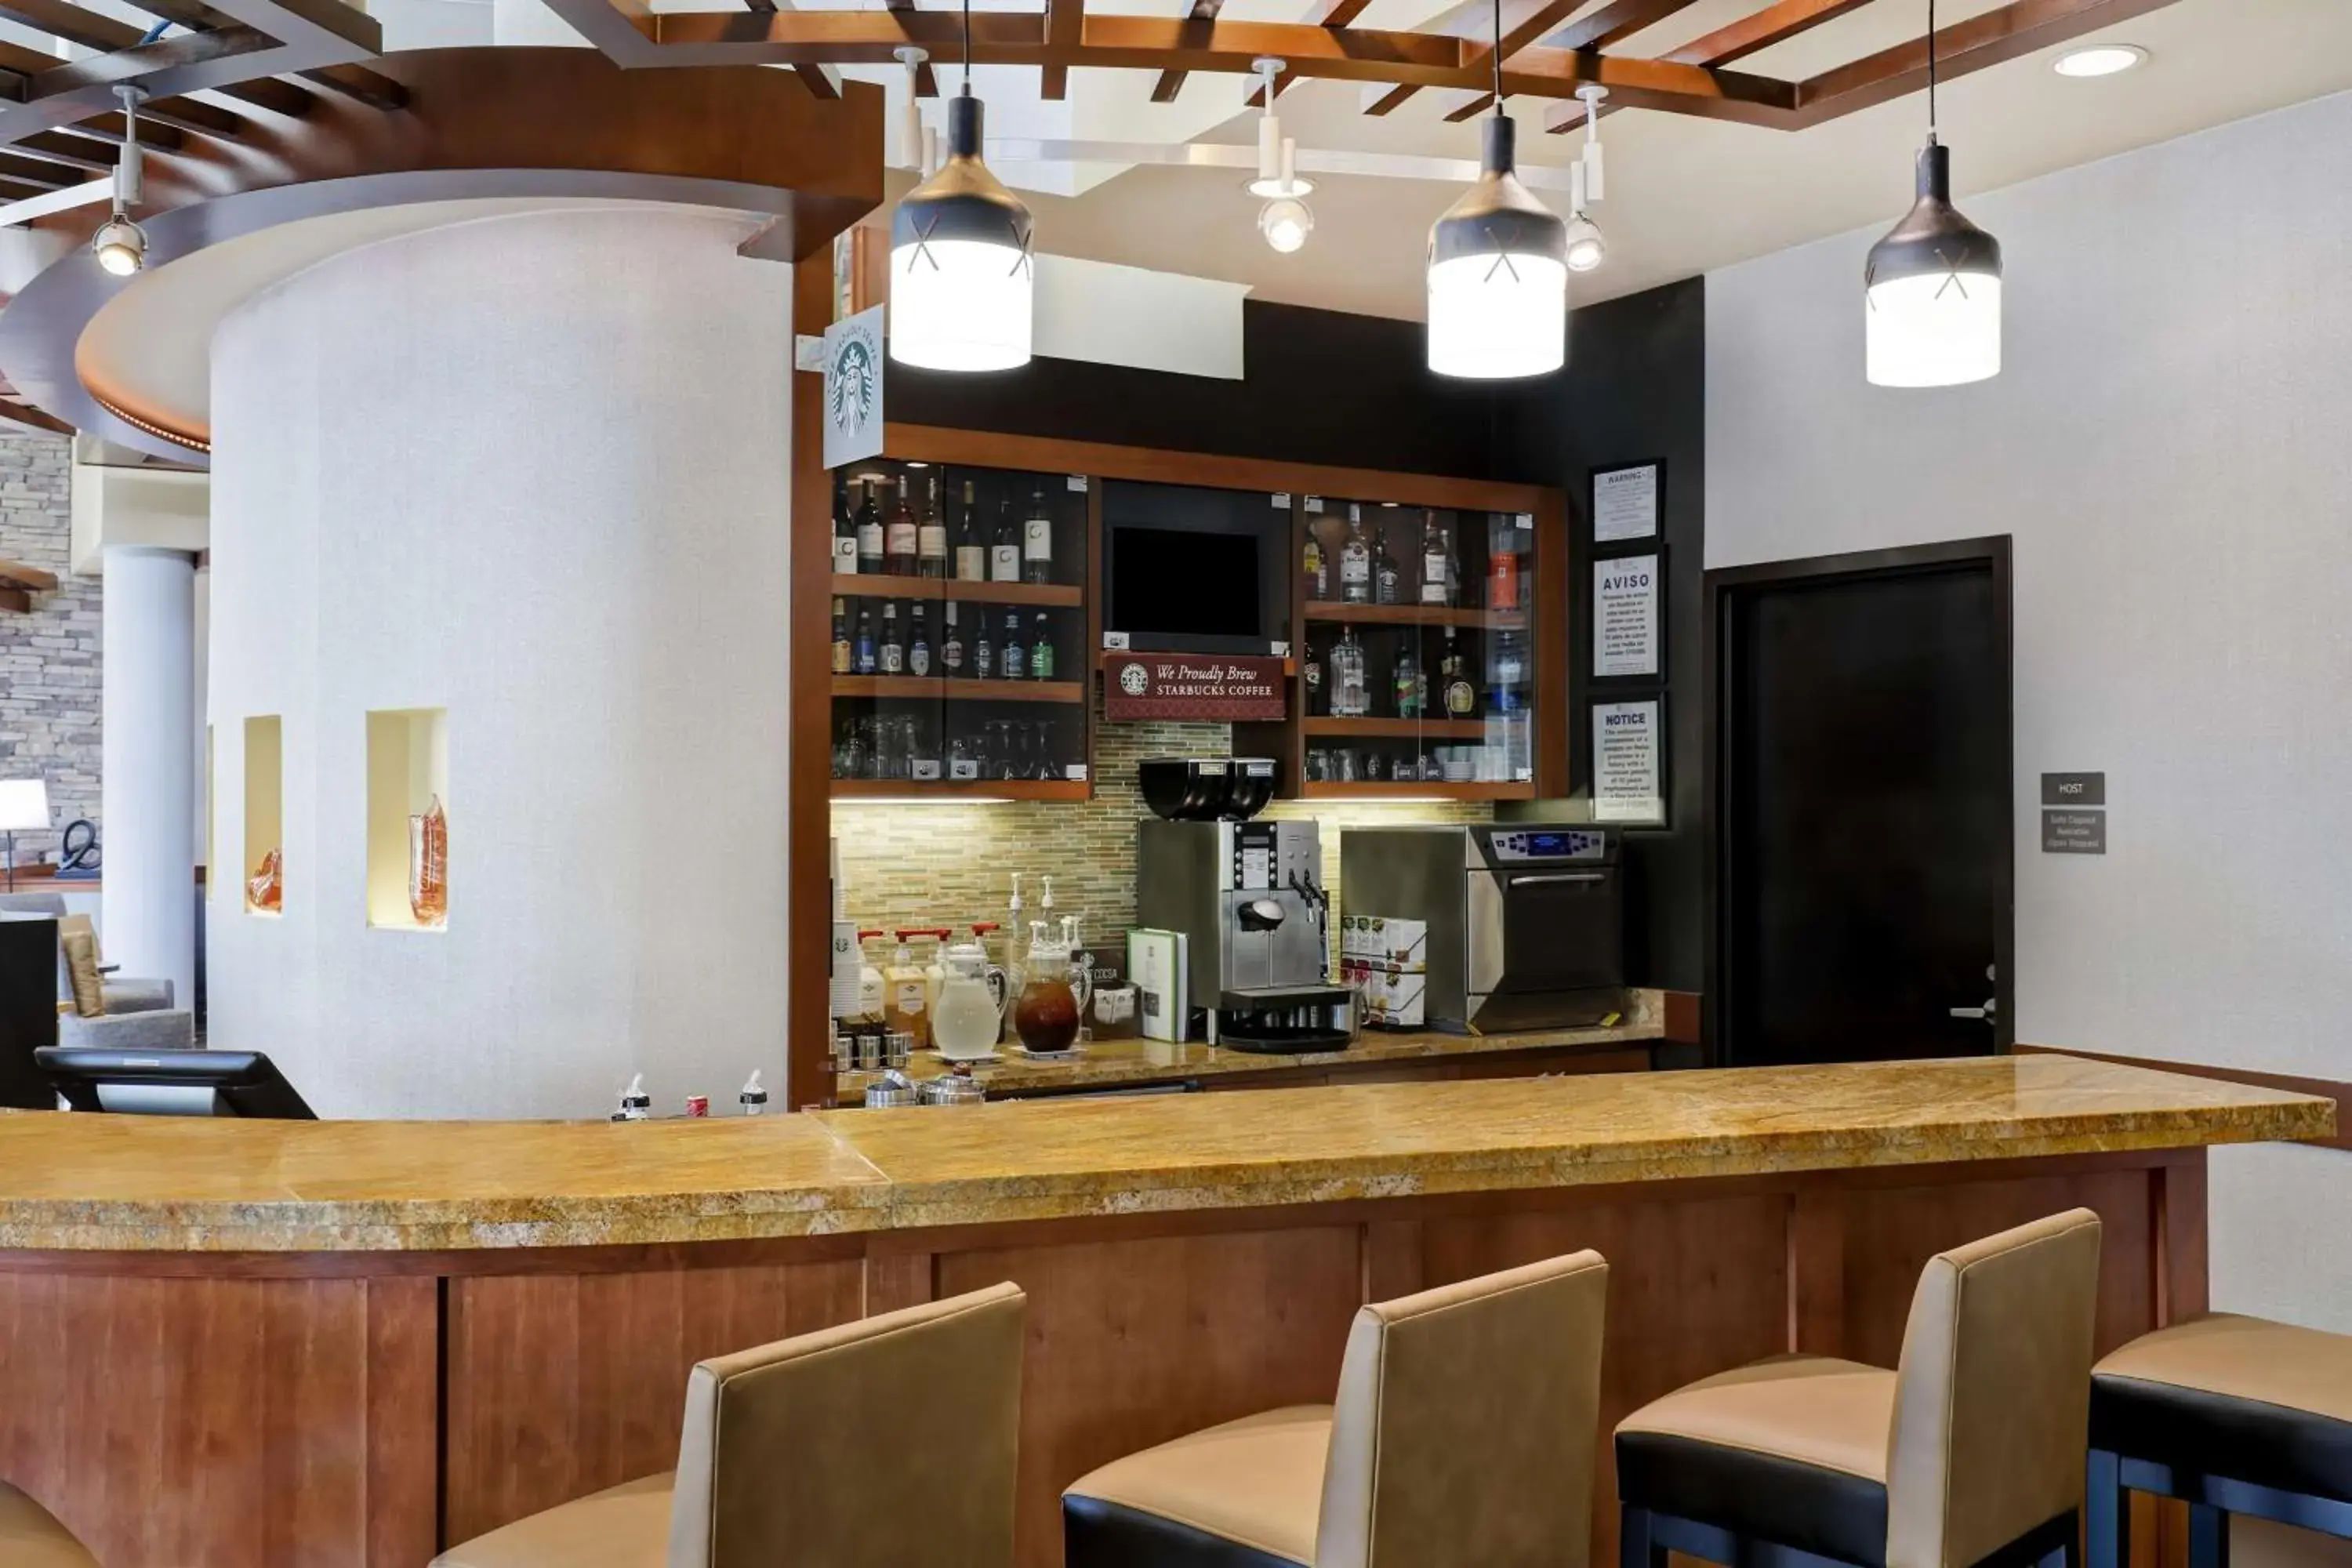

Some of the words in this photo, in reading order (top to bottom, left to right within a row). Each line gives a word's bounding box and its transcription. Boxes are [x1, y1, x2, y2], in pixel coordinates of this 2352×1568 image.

[1603, 574, 1649, 590] AVISO
[1157, 665, 1175, 679] We
[1178, 665, 1224, 684] Proudly
[1227, 666, 1258, 680] Brew
[1157, 685, 1225, 695] STARBUCKS
[1229, 685, 1272, 695] COFFEE
[1606, 713, 1646, 726] NOTICE
[2059, 783, 2082, 793] HOST
